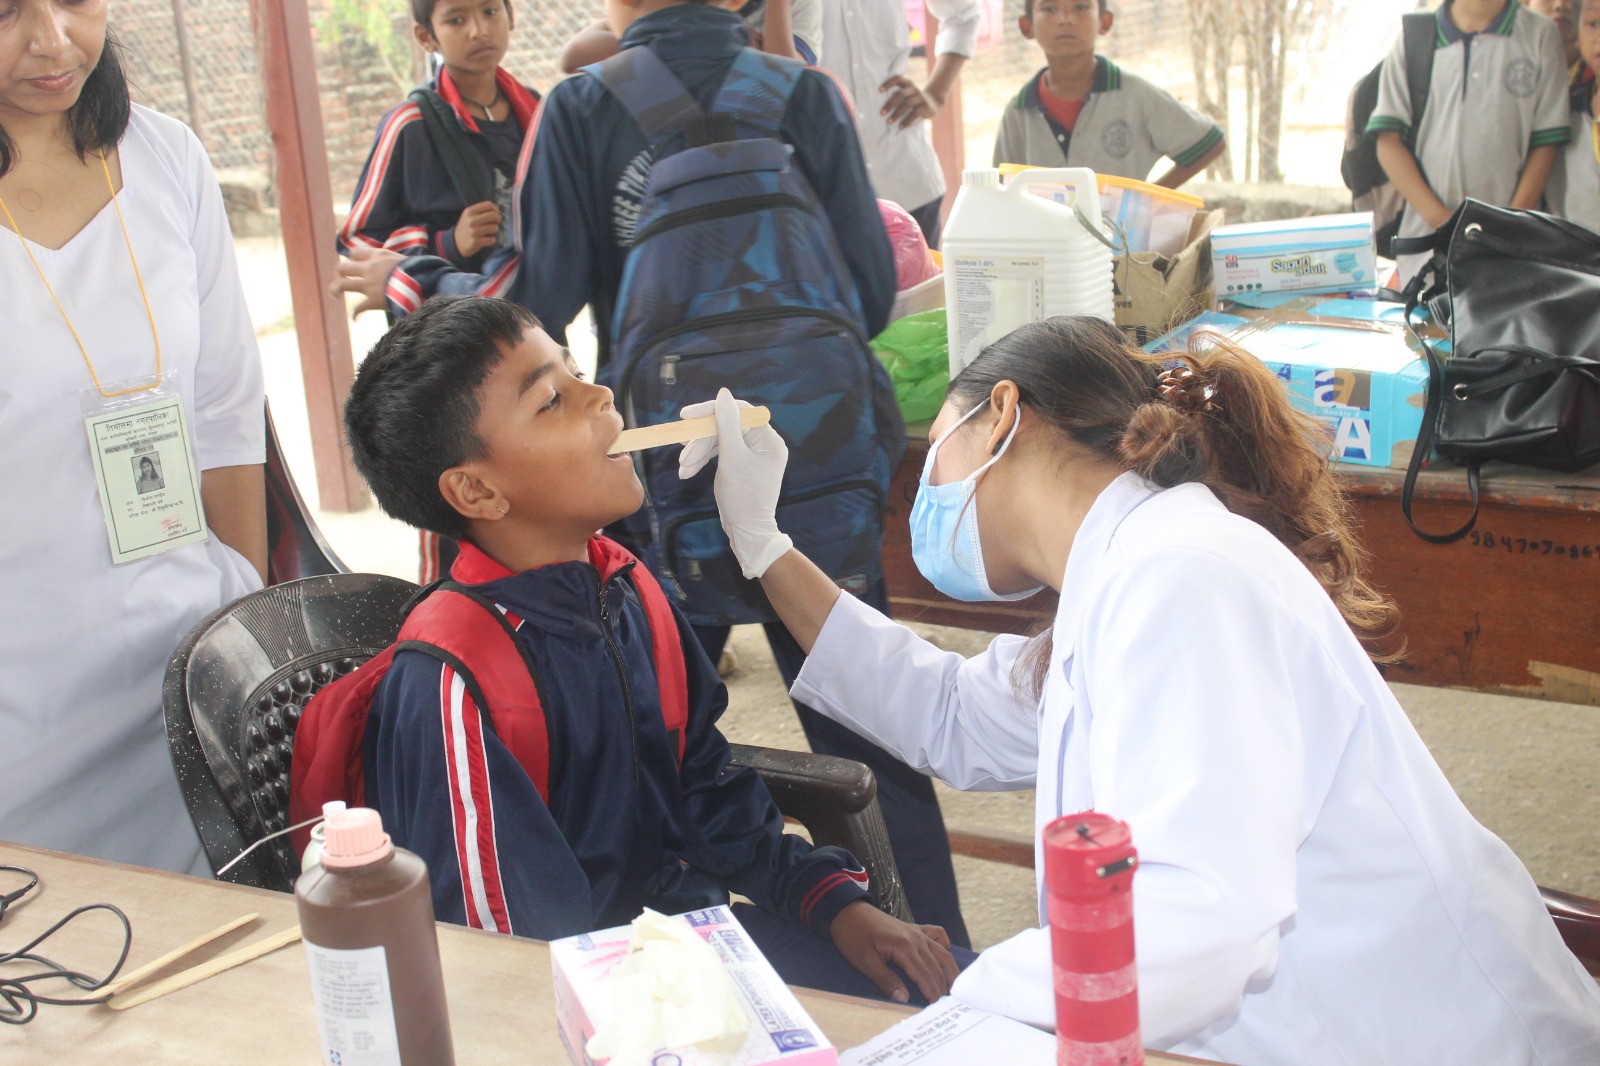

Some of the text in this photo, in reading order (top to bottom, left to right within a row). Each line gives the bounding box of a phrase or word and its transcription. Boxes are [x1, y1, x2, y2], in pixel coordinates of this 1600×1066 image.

[1272, 256, 1311, 273] Sagun
[1296, 264, 1327, 277] adult
[136, 412, 169, 425] नगरपालिका
